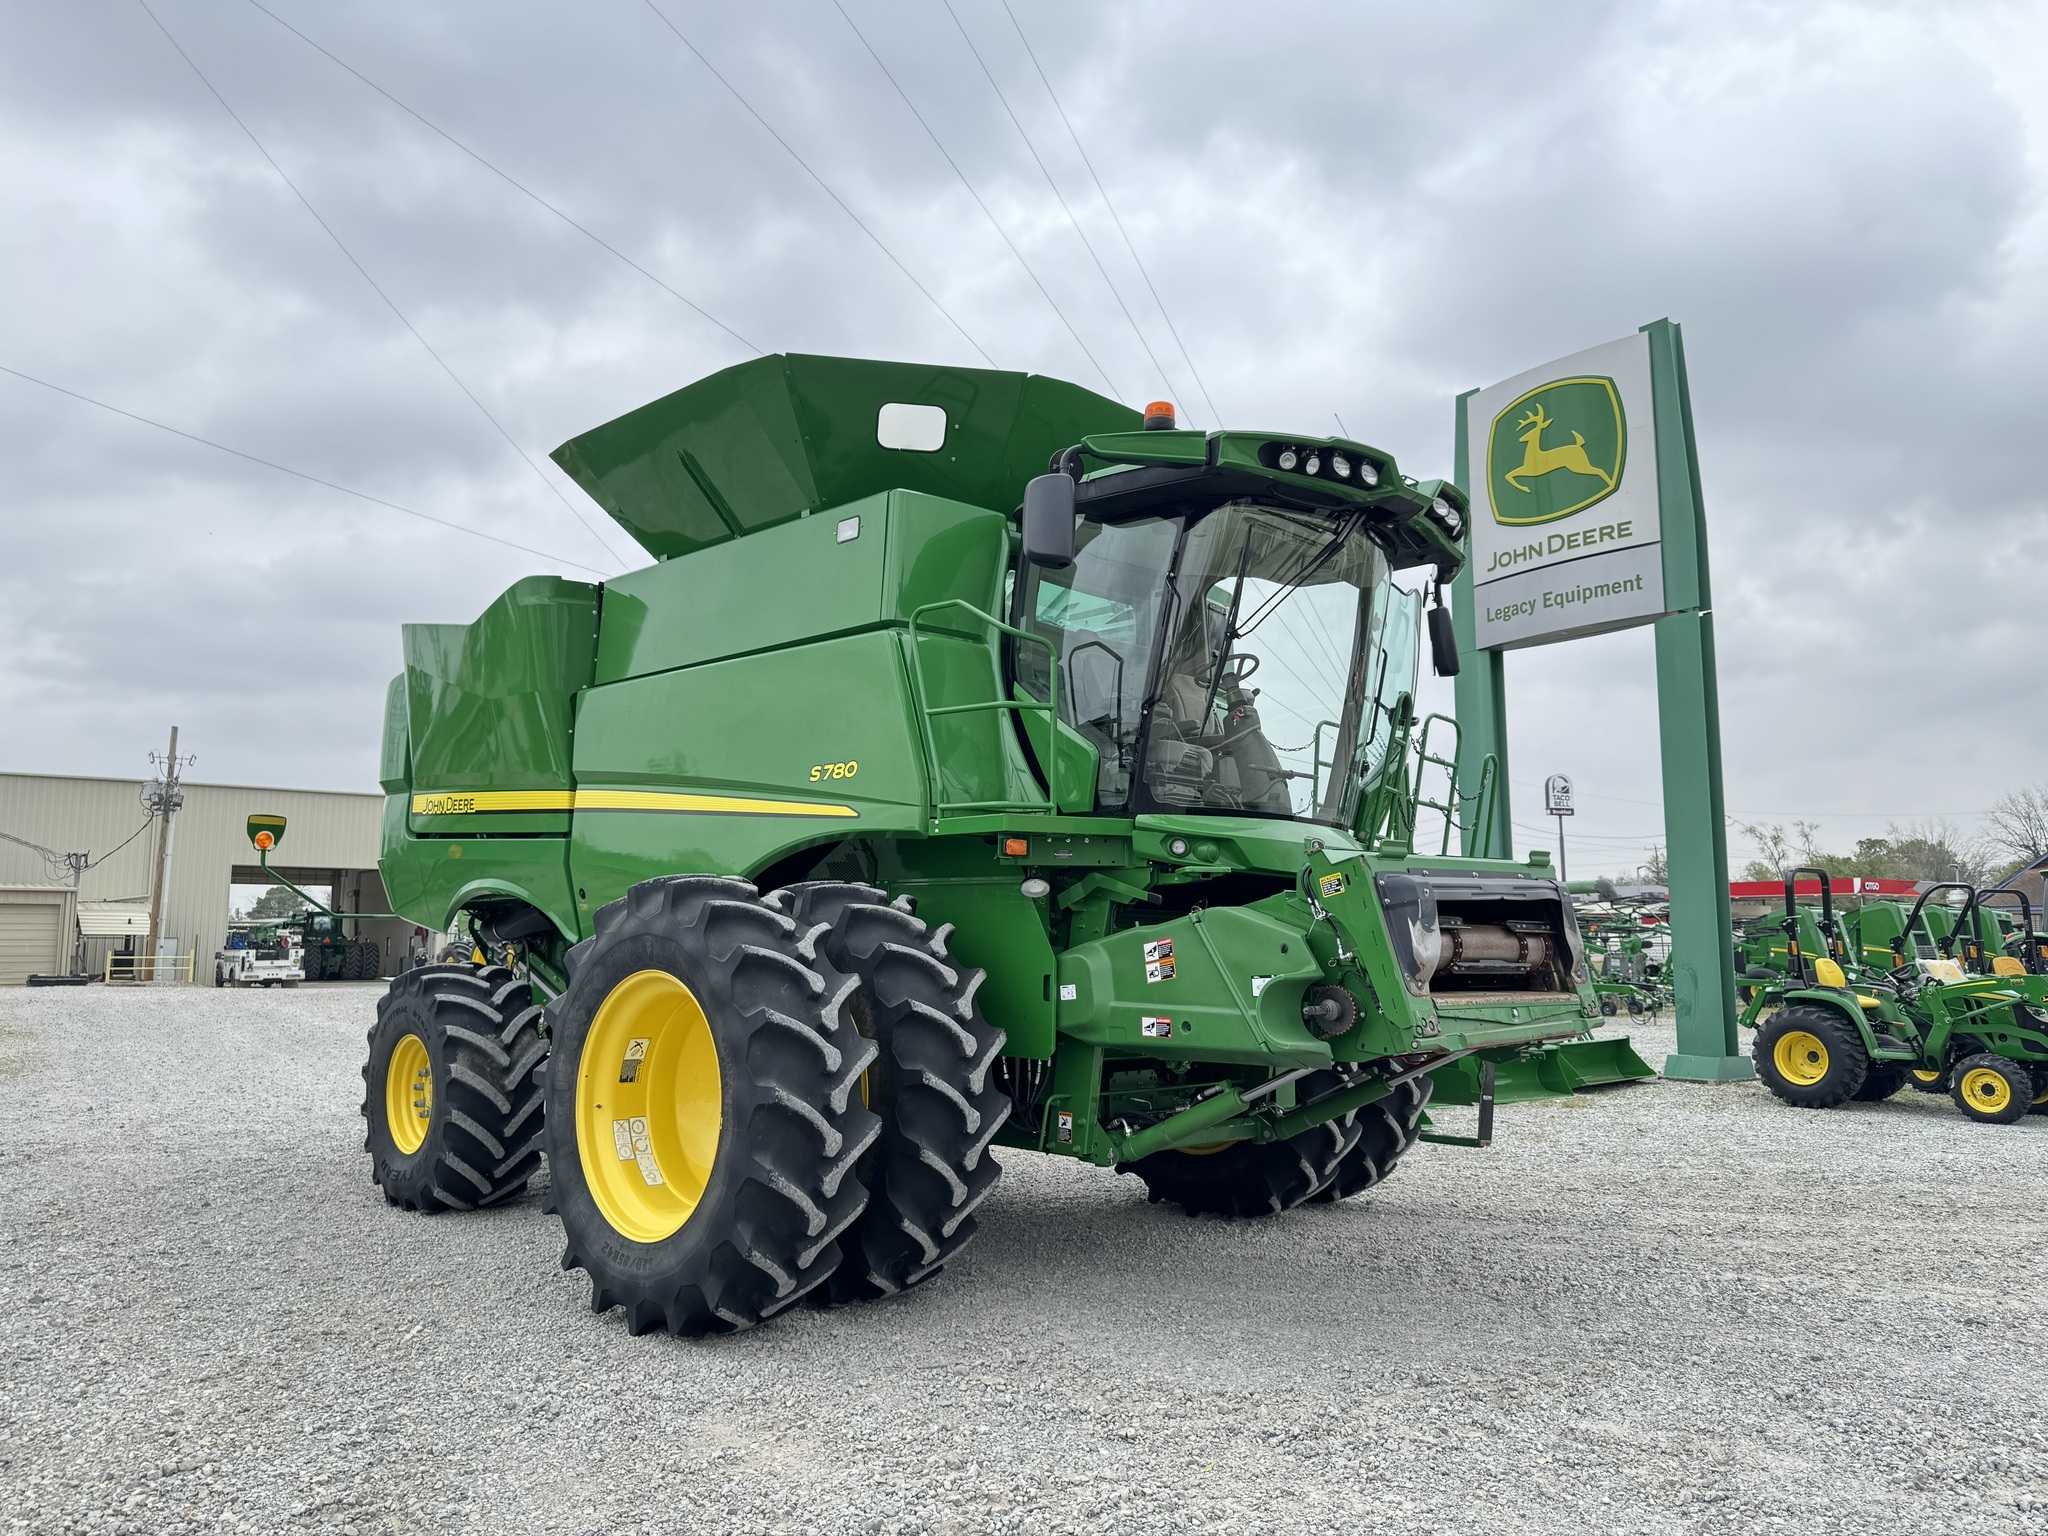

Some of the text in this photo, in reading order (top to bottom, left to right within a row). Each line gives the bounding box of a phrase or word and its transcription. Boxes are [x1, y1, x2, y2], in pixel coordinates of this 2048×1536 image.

[1487, 520, 1633, 572] JOHN DEERE
[1486, 573, 1643, 623] Legacy Equipment
[809, 760, 858, 782] S780
[422, 796, 475, 812] JOHN DEERE
